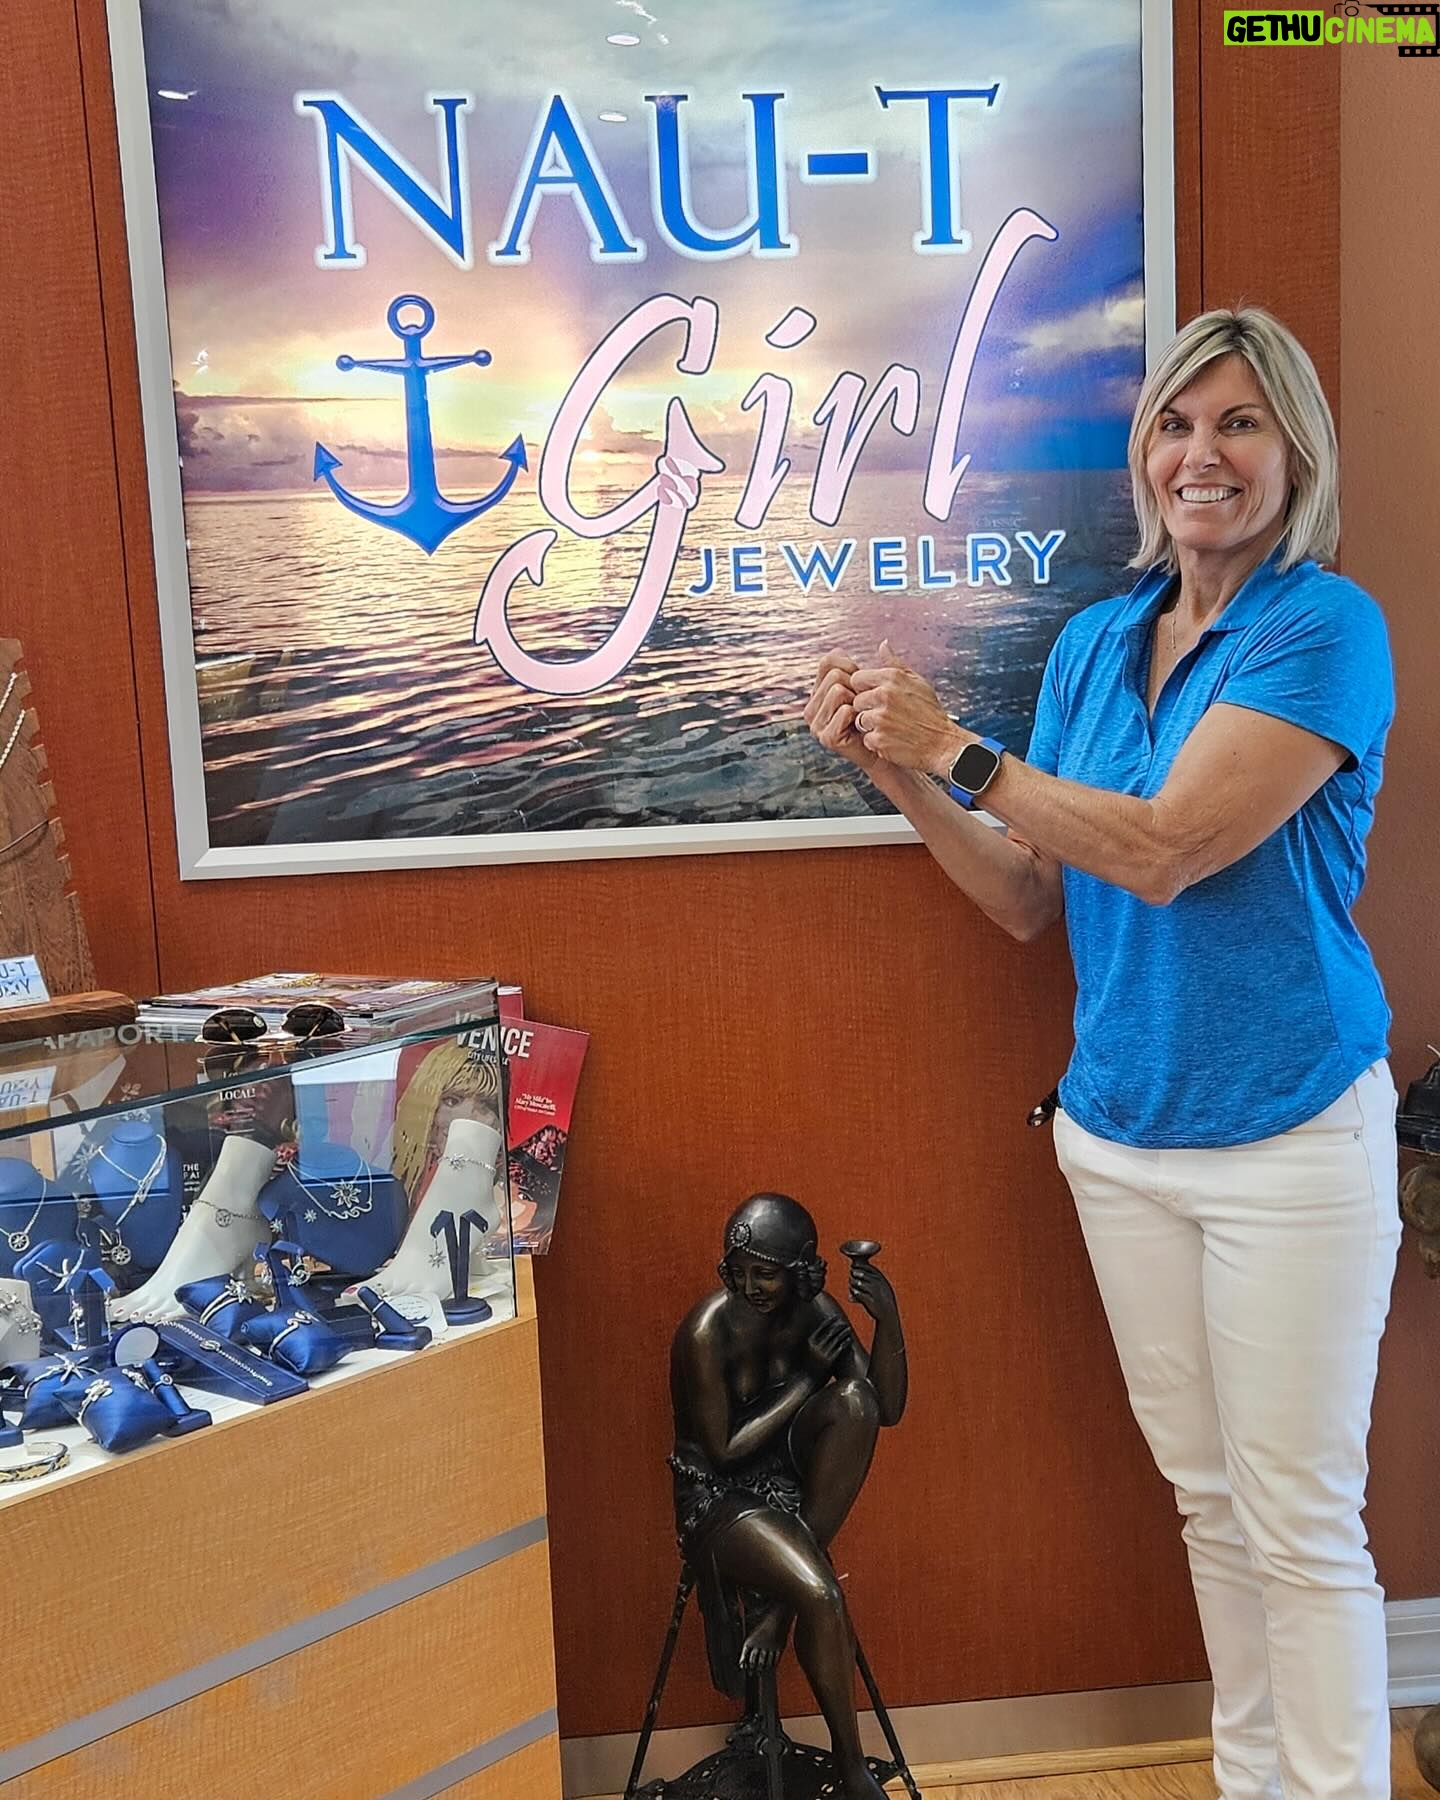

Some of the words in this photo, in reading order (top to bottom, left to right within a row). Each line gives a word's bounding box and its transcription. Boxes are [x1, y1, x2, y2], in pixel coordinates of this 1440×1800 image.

[299, 82, 1002, 267] NAU-T
[473, 207, 1060, 694] Girl
[686, 529, 1066, 596] JEWELRY
[220, 1088, 256, 1101] LOCAL!
